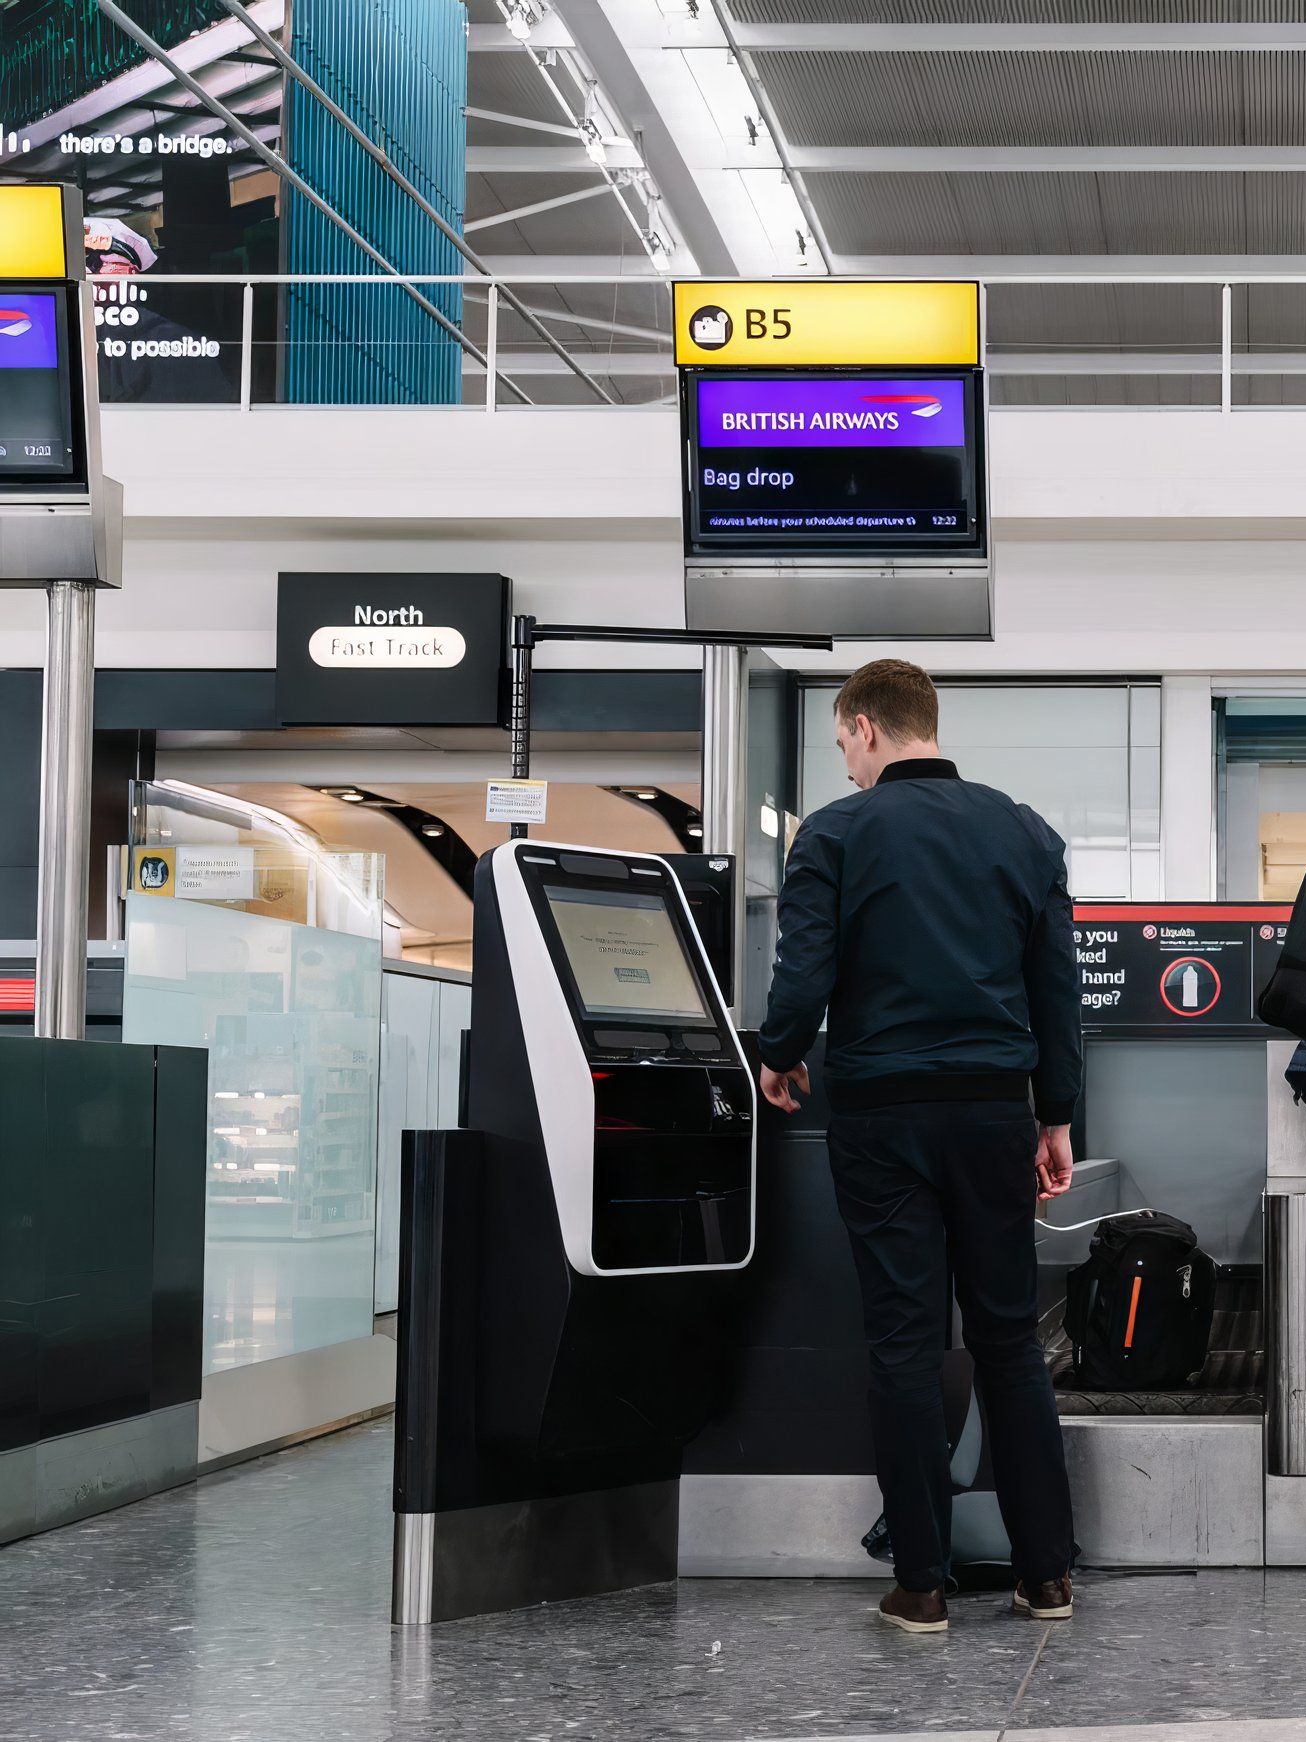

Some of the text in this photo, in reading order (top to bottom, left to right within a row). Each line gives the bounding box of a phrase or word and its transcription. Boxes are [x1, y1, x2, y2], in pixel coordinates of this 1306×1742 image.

[59, 132, 232, 158] there's a bridge.
[745, 308, 792, 340] B5
[104, 336, 220, 361] to possible
[722, 412, 899, 430] BRITISH AIRWAYS
[703, 467, 794, 490] Bag drop
[354, 604, 424, 626] North
[331, 638, 444, 656] Fast Track
[1085, 930, 1118, 946] you
[1076, 948, 1107, 963] ked
[1082, 968, 1125, 984] hand
